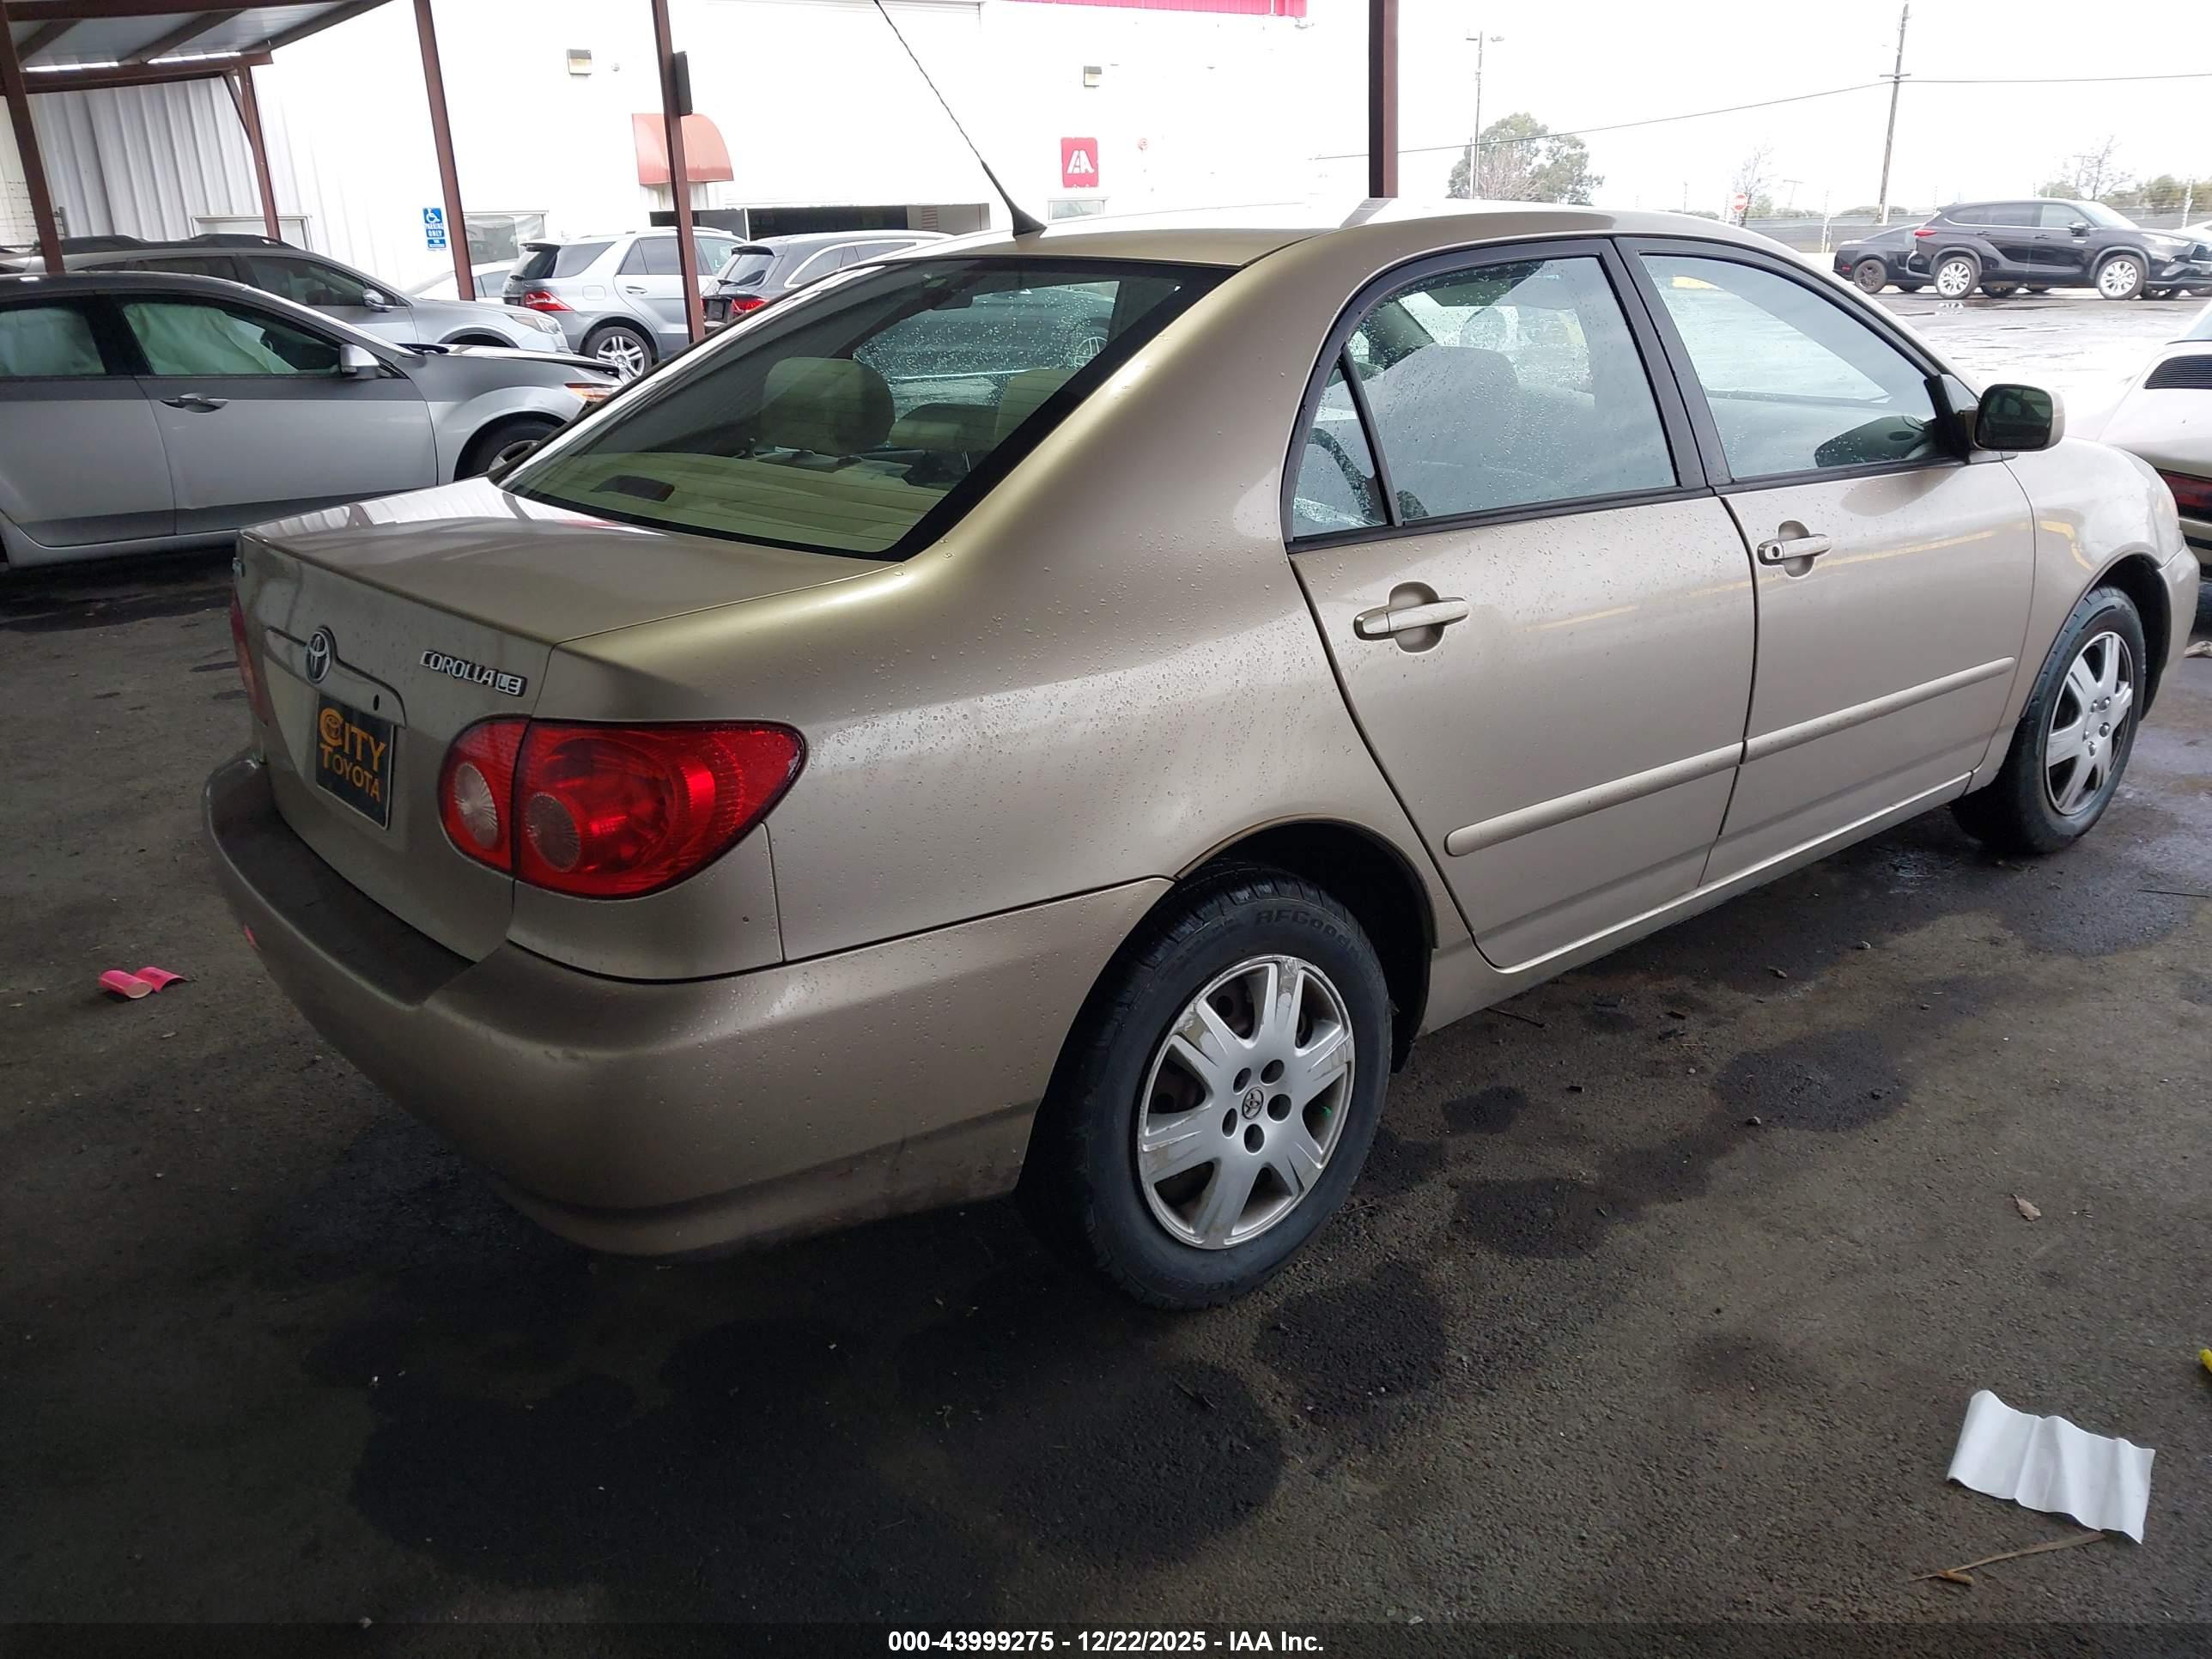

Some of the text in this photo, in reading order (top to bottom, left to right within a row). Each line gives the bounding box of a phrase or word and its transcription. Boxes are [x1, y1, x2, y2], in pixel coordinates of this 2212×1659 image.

[420, 650, 526, 696] COROLLA LE
[319, 707, 386, 771] CITY
[319, 742, 381, 803] TOYOTA
